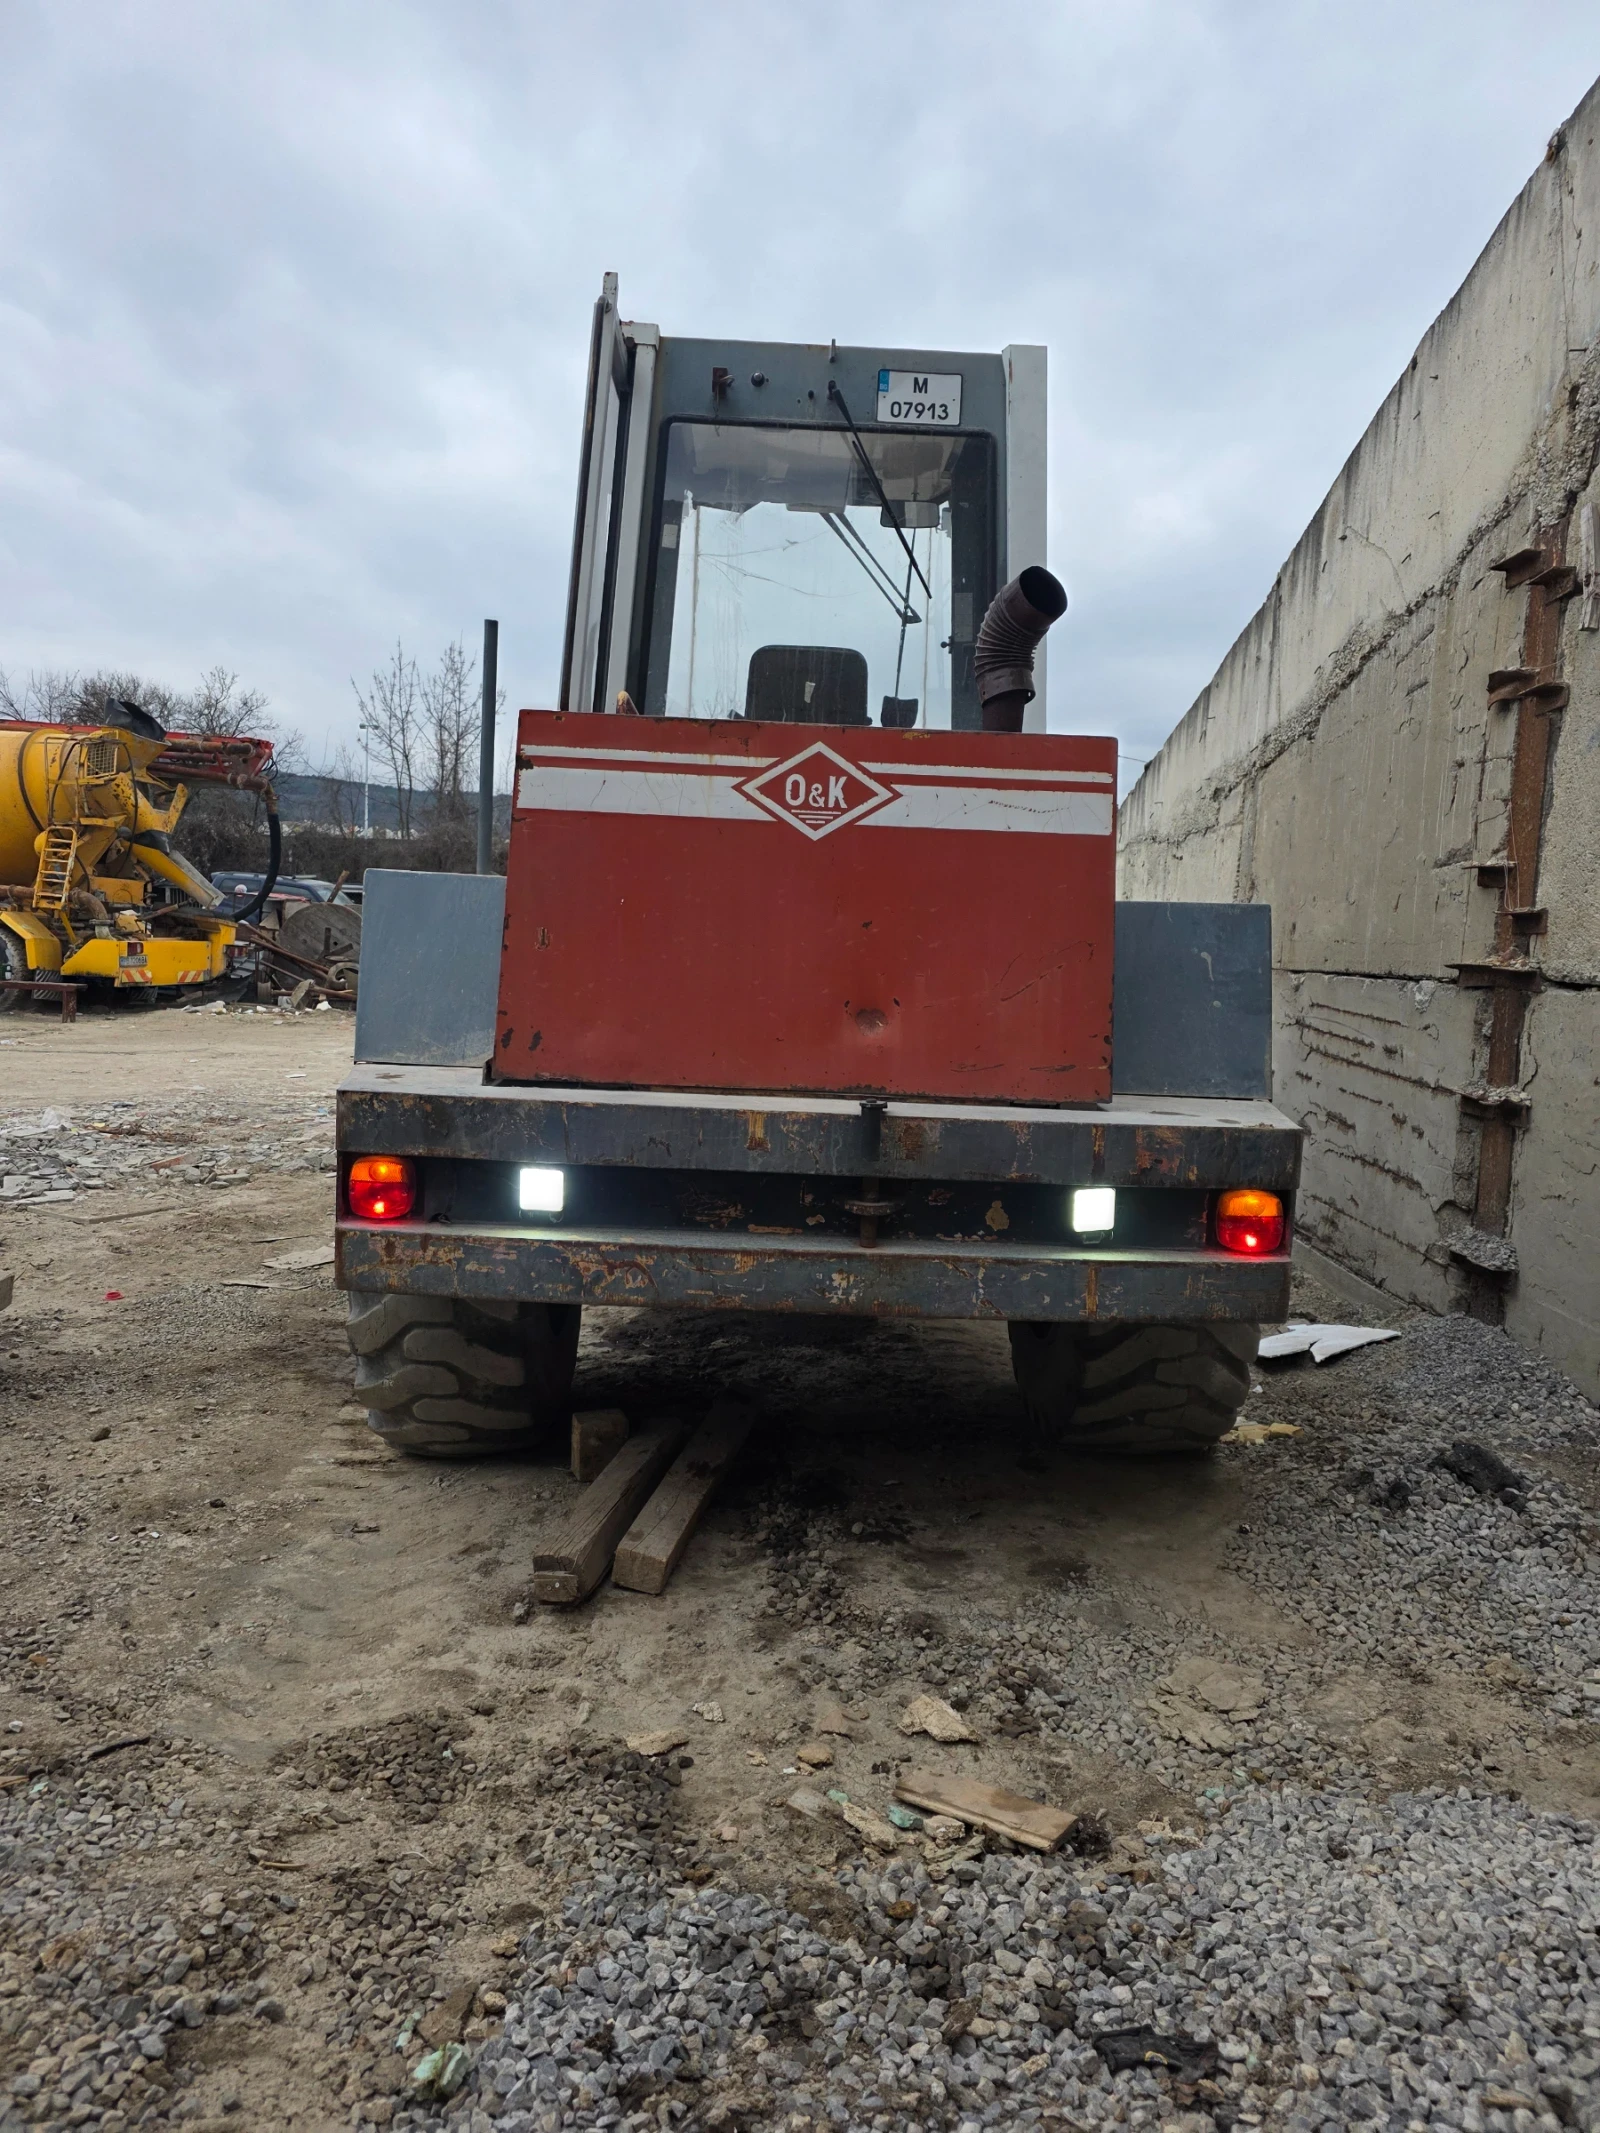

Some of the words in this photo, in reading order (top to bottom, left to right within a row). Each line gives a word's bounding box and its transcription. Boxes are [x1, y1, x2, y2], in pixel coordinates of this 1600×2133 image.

[913, 376, 928, 394] M
[890, 401, 949, 420] 07913
[785, 773, 848, 808] O&K
